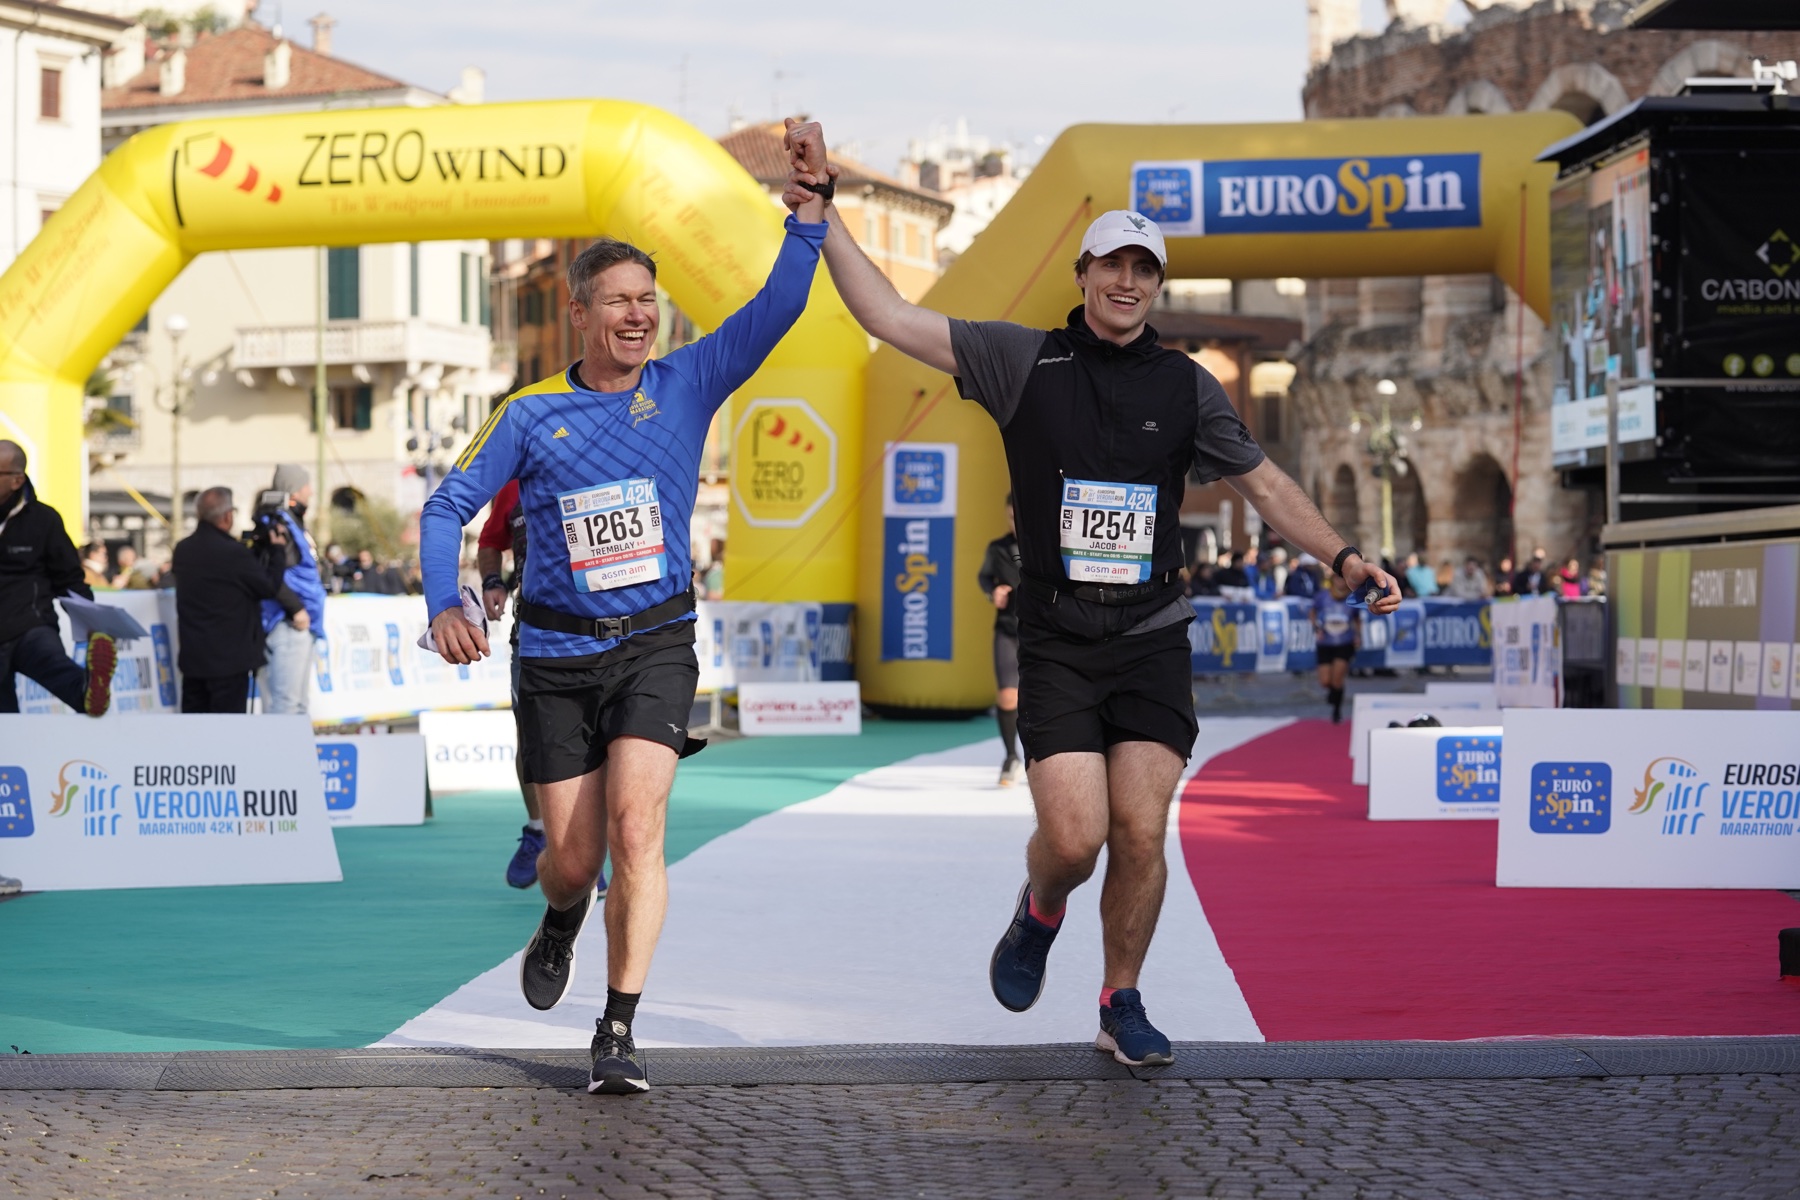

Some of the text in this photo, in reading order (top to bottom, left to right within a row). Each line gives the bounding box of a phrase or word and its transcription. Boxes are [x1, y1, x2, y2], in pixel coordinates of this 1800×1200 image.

[298, 129, 567, 187] ZERO WIND
[1218, 159, 1466, 229] EUROSpin
[752, 460, 805, 486] ZERO
[625, 481, 655, 505] 42K
[1127, 492, 1155, 511] 42K
[583, 506, 644, 547] 1263
[1082, 509, 1137, 541] 1254
[591, 541, 635, 557] TREMBLAY
[1089, 541, 1117, 551] JACOB
[629, 564, 647, 576] aim
[1111, 567, 1129, 575] aim
[1457, 750, 1497, 765] EURO
[134, 765, 236, 787] EUROSPIN
[1451, 764, 1499, 789] Spin
[1552, 779, 1593, 793] EURO
[135, 790, 298, 819] VERONA RUN
[1545, 793, 1595, 819] Spin
[139, 822, 206, 836] MARATHON
[210, 821, 234, 834] 42K
[245, 820, 266, 834] 21K
[277, 819, 298, 833] 10K
[1720, 822, 1794, 837] MARATHON
